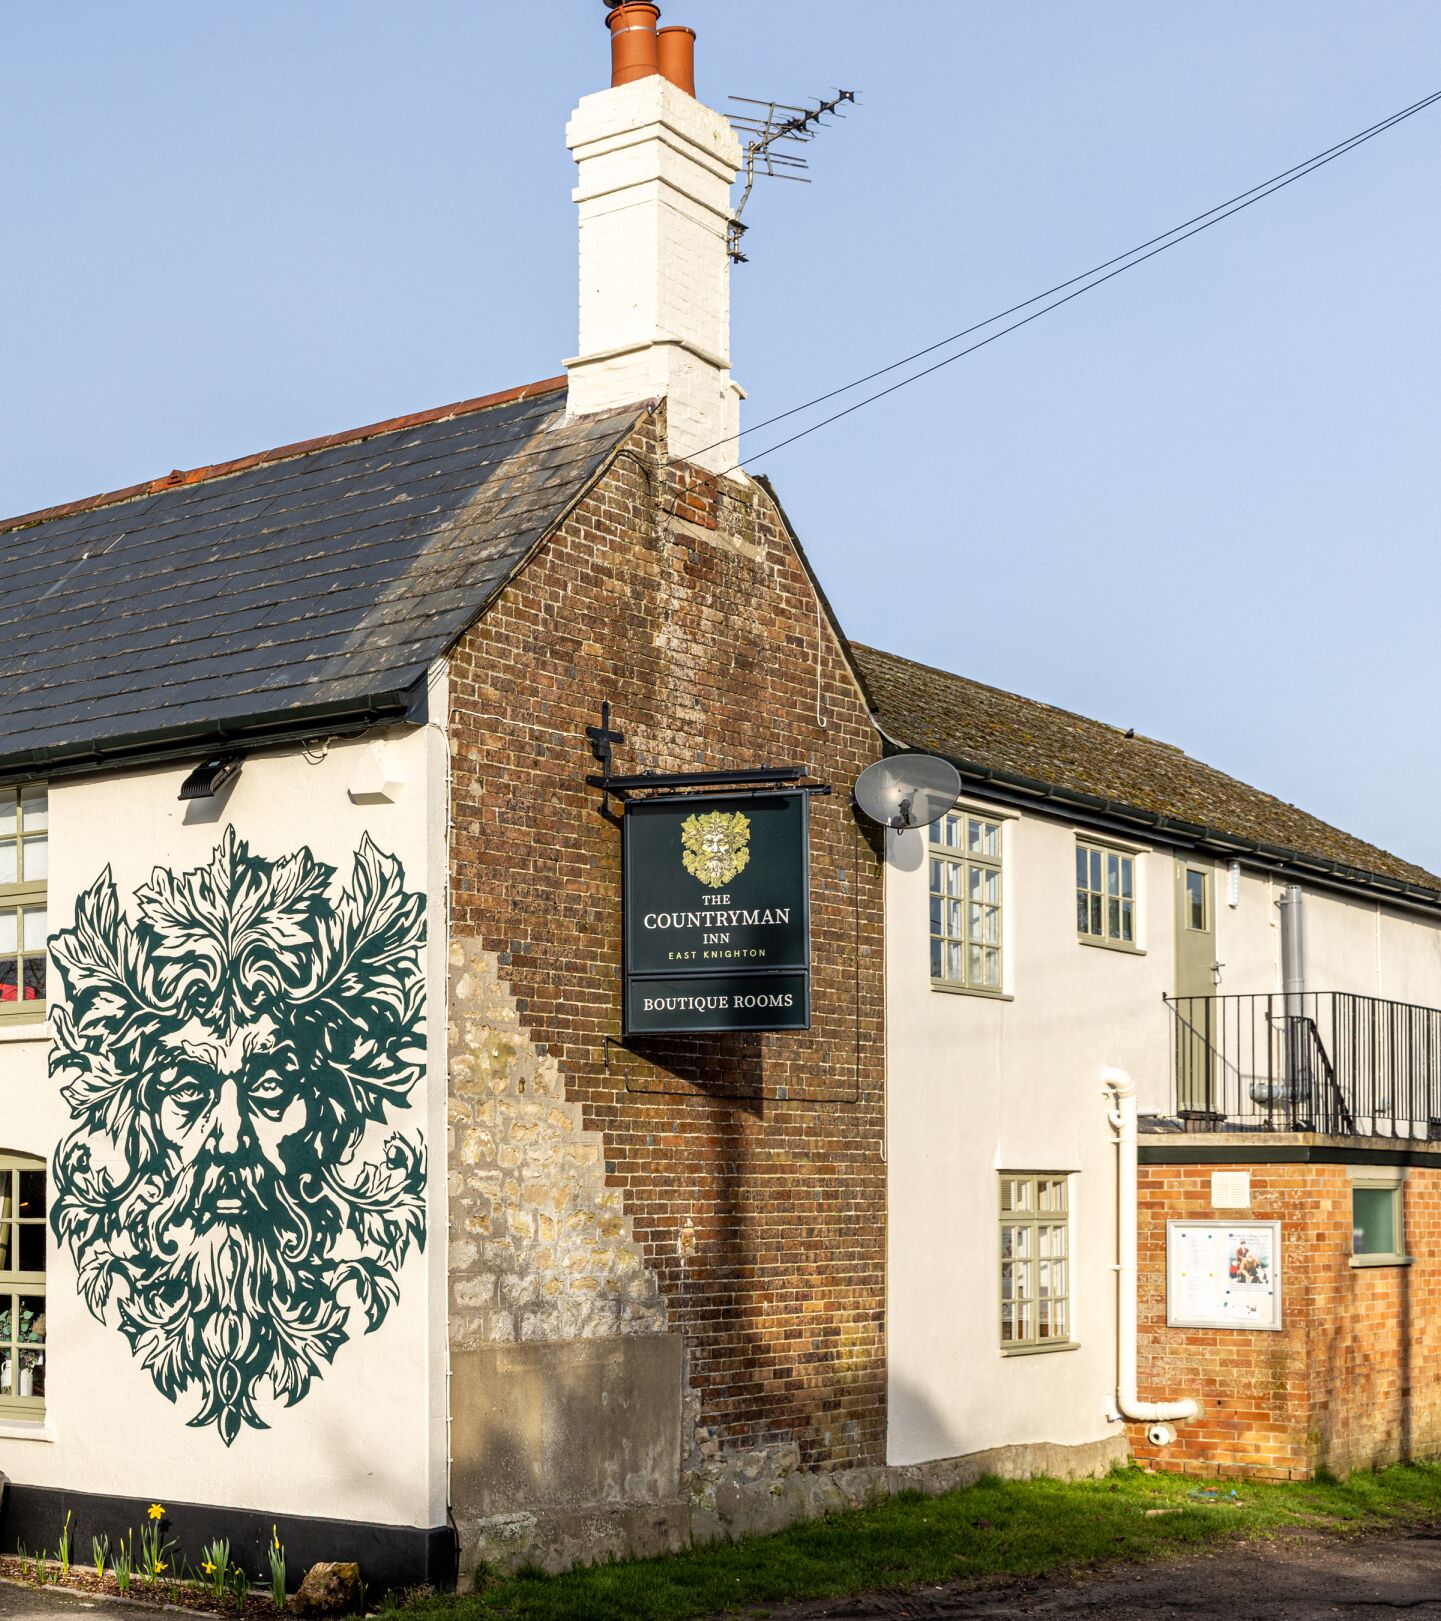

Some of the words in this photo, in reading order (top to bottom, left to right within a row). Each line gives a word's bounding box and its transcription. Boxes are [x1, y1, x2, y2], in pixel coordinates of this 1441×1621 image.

[702, 894, 731, 906] THE
[643, 908, 791, 929] COUNTRYMAN
[702, 933, 730, 944] INN
[668, 951, 697, 960] EAST
[703, 949, 767, 959] KNIGHTON
[643, 995, 729, 1012] BOUTIQUE
[733, 994, 793, 1009] ROOMS
